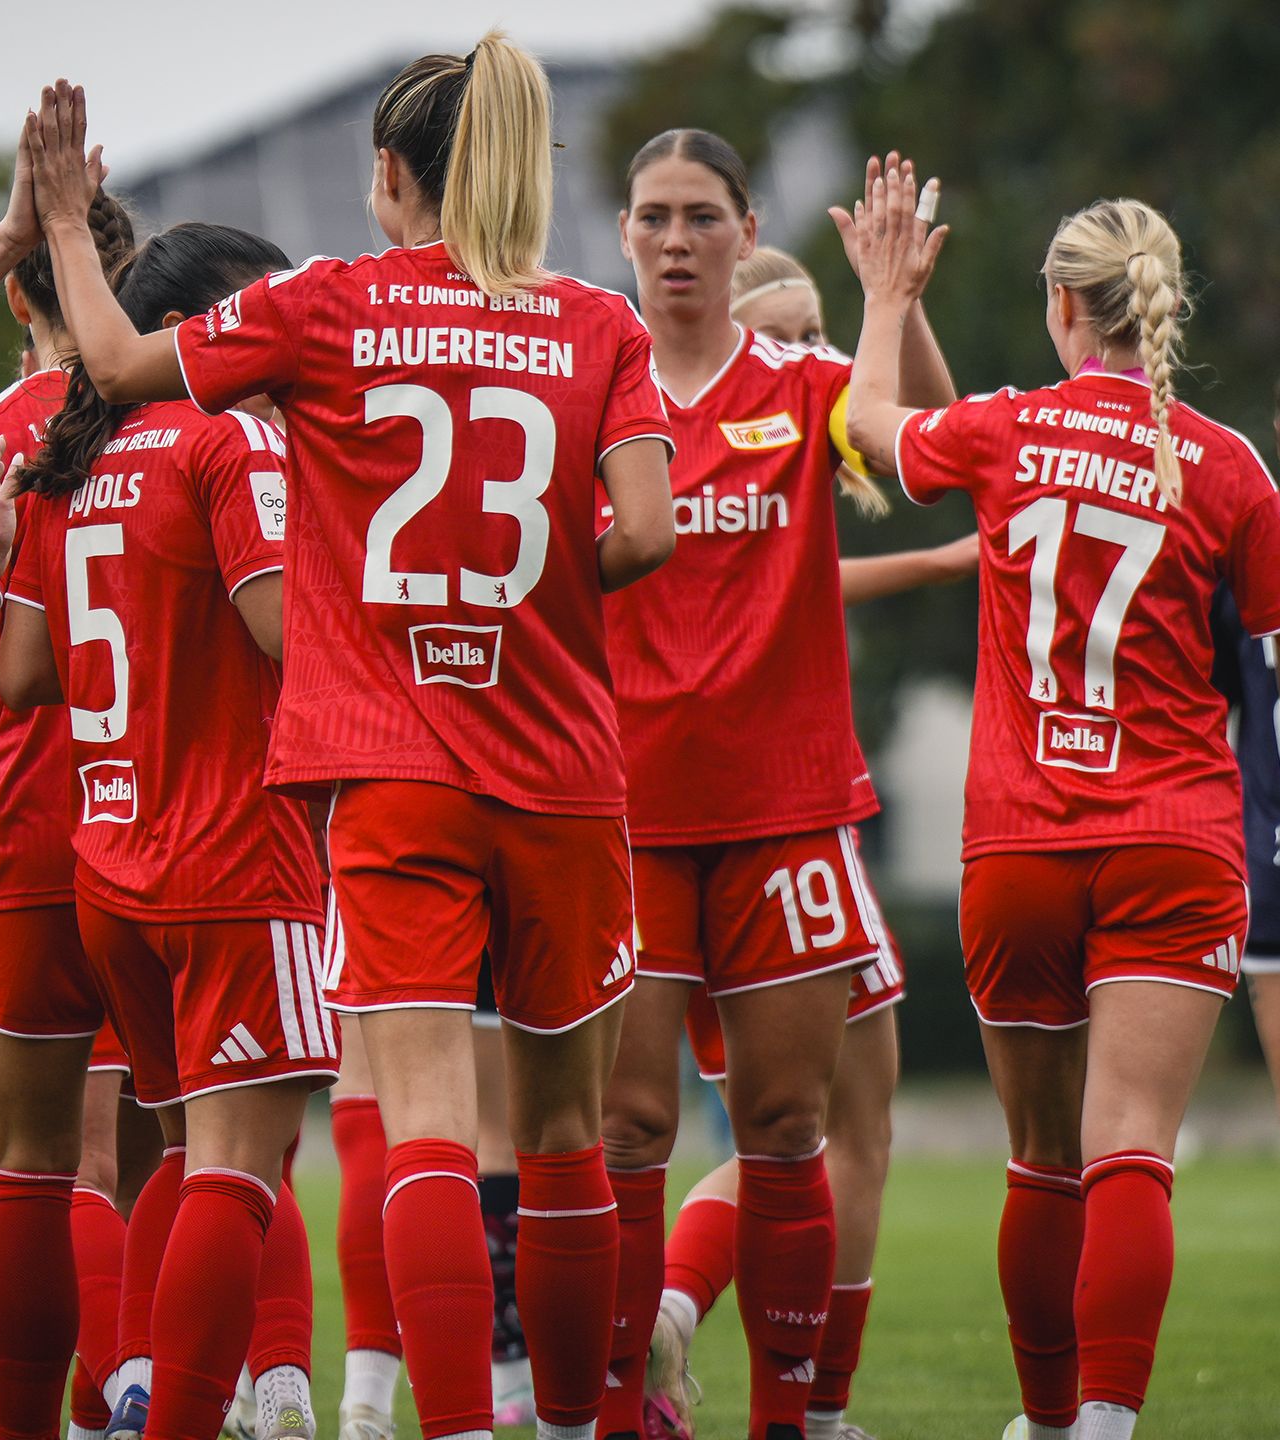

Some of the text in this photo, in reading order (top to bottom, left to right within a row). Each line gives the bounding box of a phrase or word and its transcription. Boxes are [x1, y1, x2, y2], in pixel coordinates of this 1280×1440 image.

[367, 284, 560, 318] 1. FC UNION BERLIN
[352, 327, 574, 378] BAUEREISEN
[126, 429, 181, 452] BERLIN
[1016, 407, 1204, 465] 1. FC UNION BELIN
[260, 492, 286, 508] Go
[361, 383, 557, 609] 23
[672, 482, 788, 534] aisin
[1008, 496, 1167, 711] 17
[65, 523, 130, 743] 5
[424, 641, 486, 666] bella
[1050, 726, 1105, 752] bella
[93, 777, 132, 803] bella
[763, 859, 846, 954] 19
